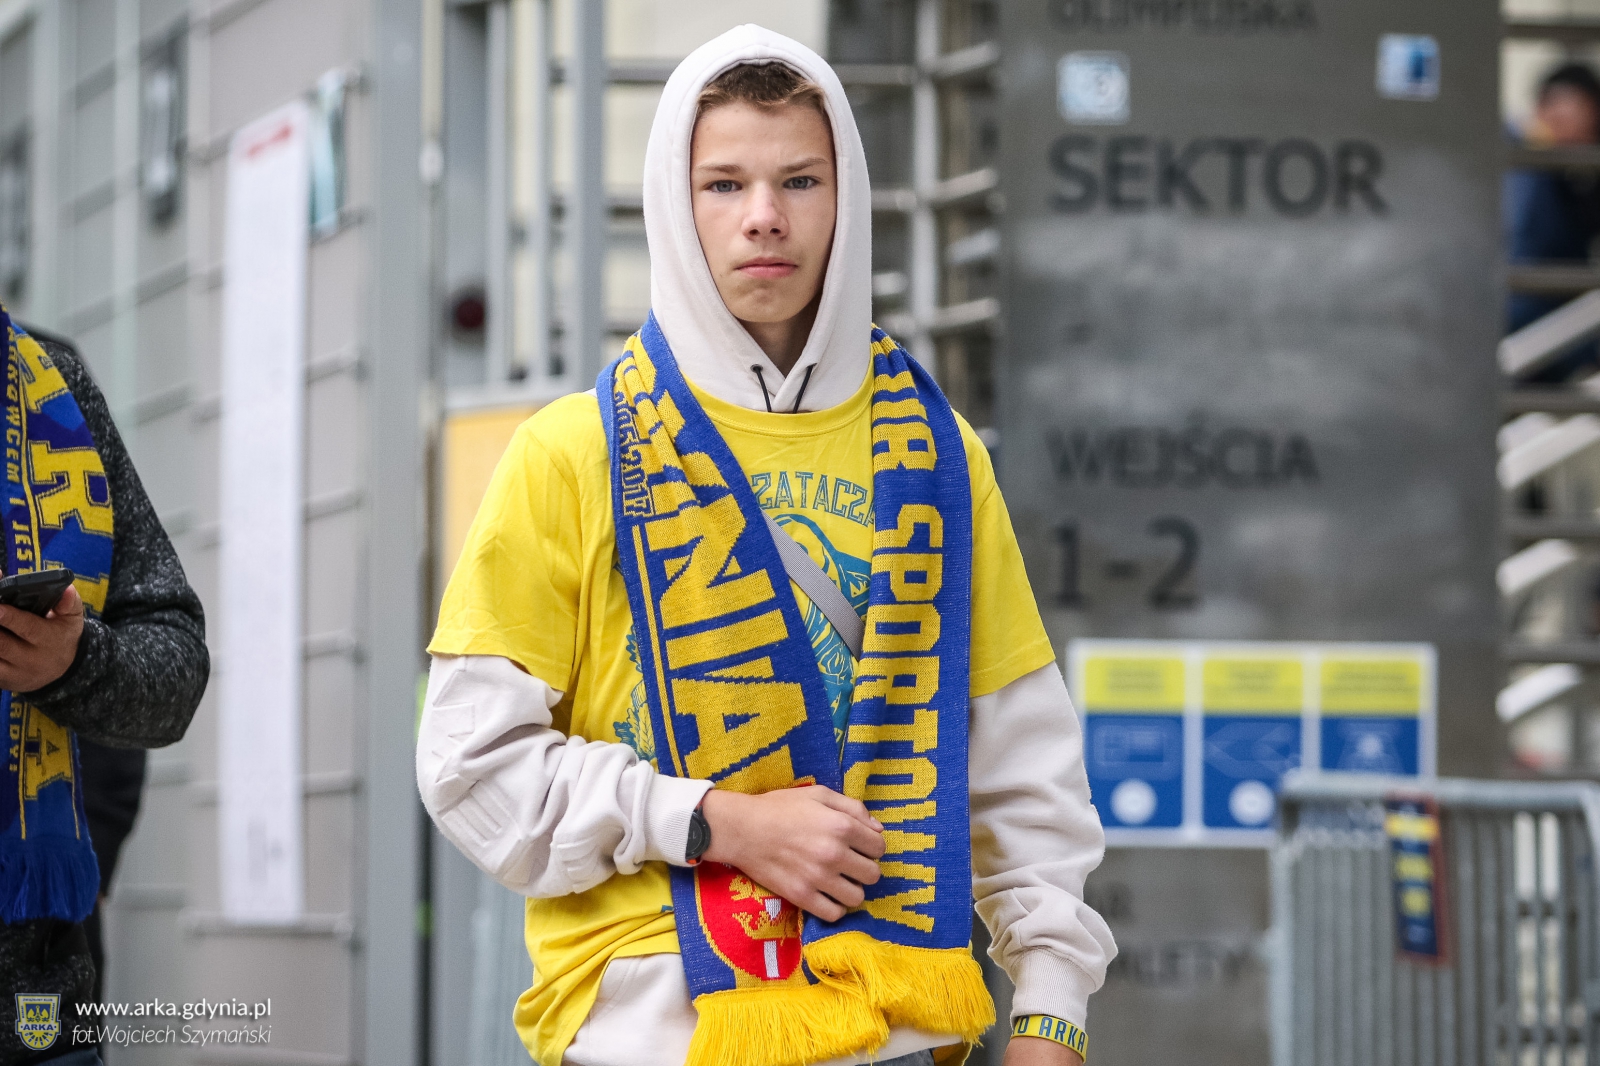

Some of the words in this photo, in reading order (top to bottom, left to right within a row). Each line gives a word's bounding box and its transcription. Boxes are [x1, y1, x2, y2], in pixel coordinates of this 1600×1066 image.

[1047, 134, 1390, 218] SEKTOR
[1043, 412, 1321, 489] WEJŚCIA
[843, 504, 944, 933] SPORTOWY
[1039, 1016, 1086, 1053] ARKA
